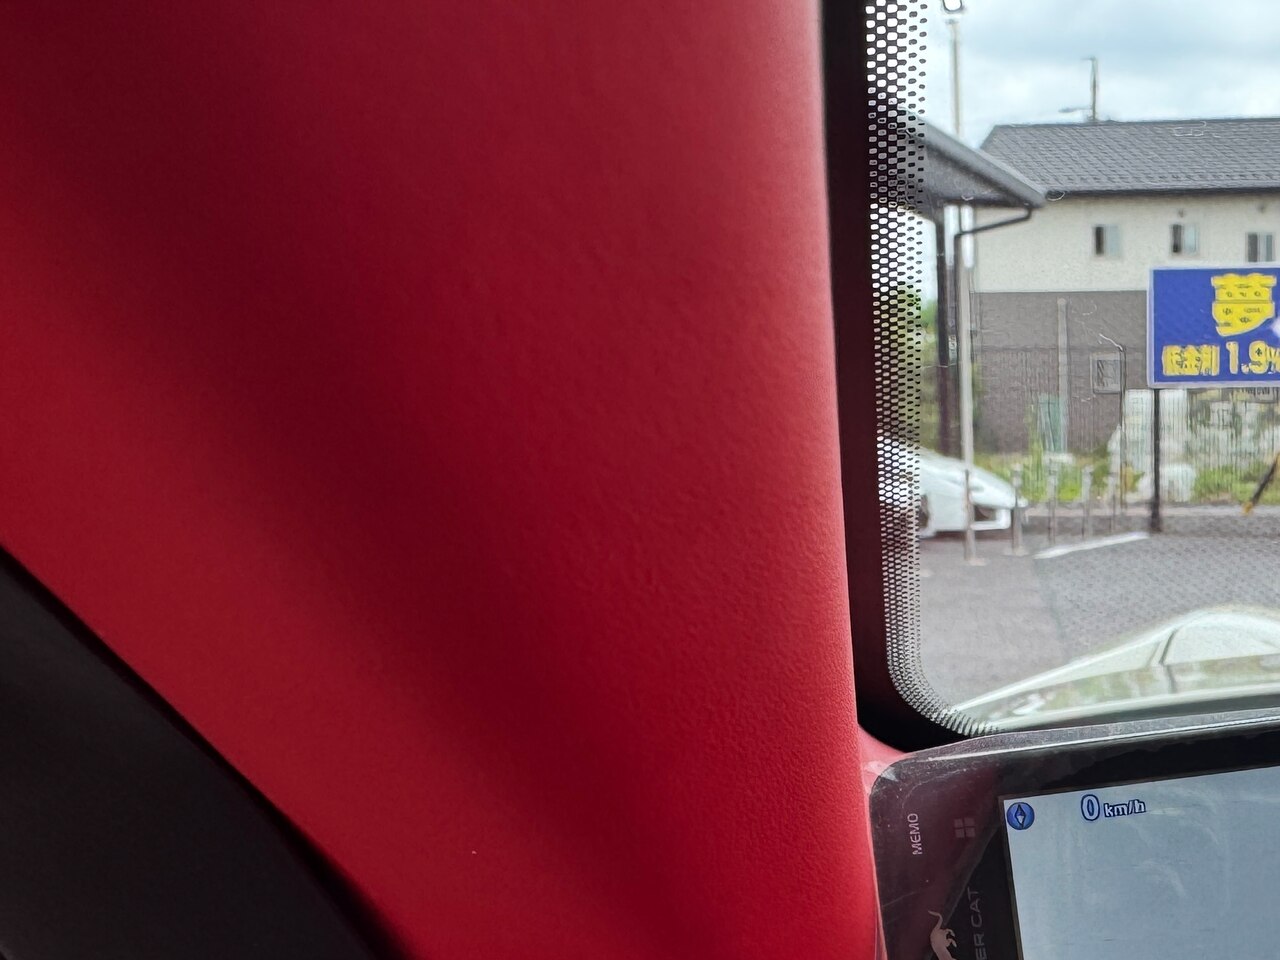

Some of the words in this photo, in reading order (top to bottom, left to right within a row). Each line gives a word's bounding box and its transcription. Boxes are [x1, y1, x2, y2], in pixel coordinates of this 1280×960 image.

[1080, 794, 1101, 821] 0
[1103, 798, 1147, 818] km/h
[907, 812, 924, 856] MEMO
[967, 886, 985, 929] CAT
